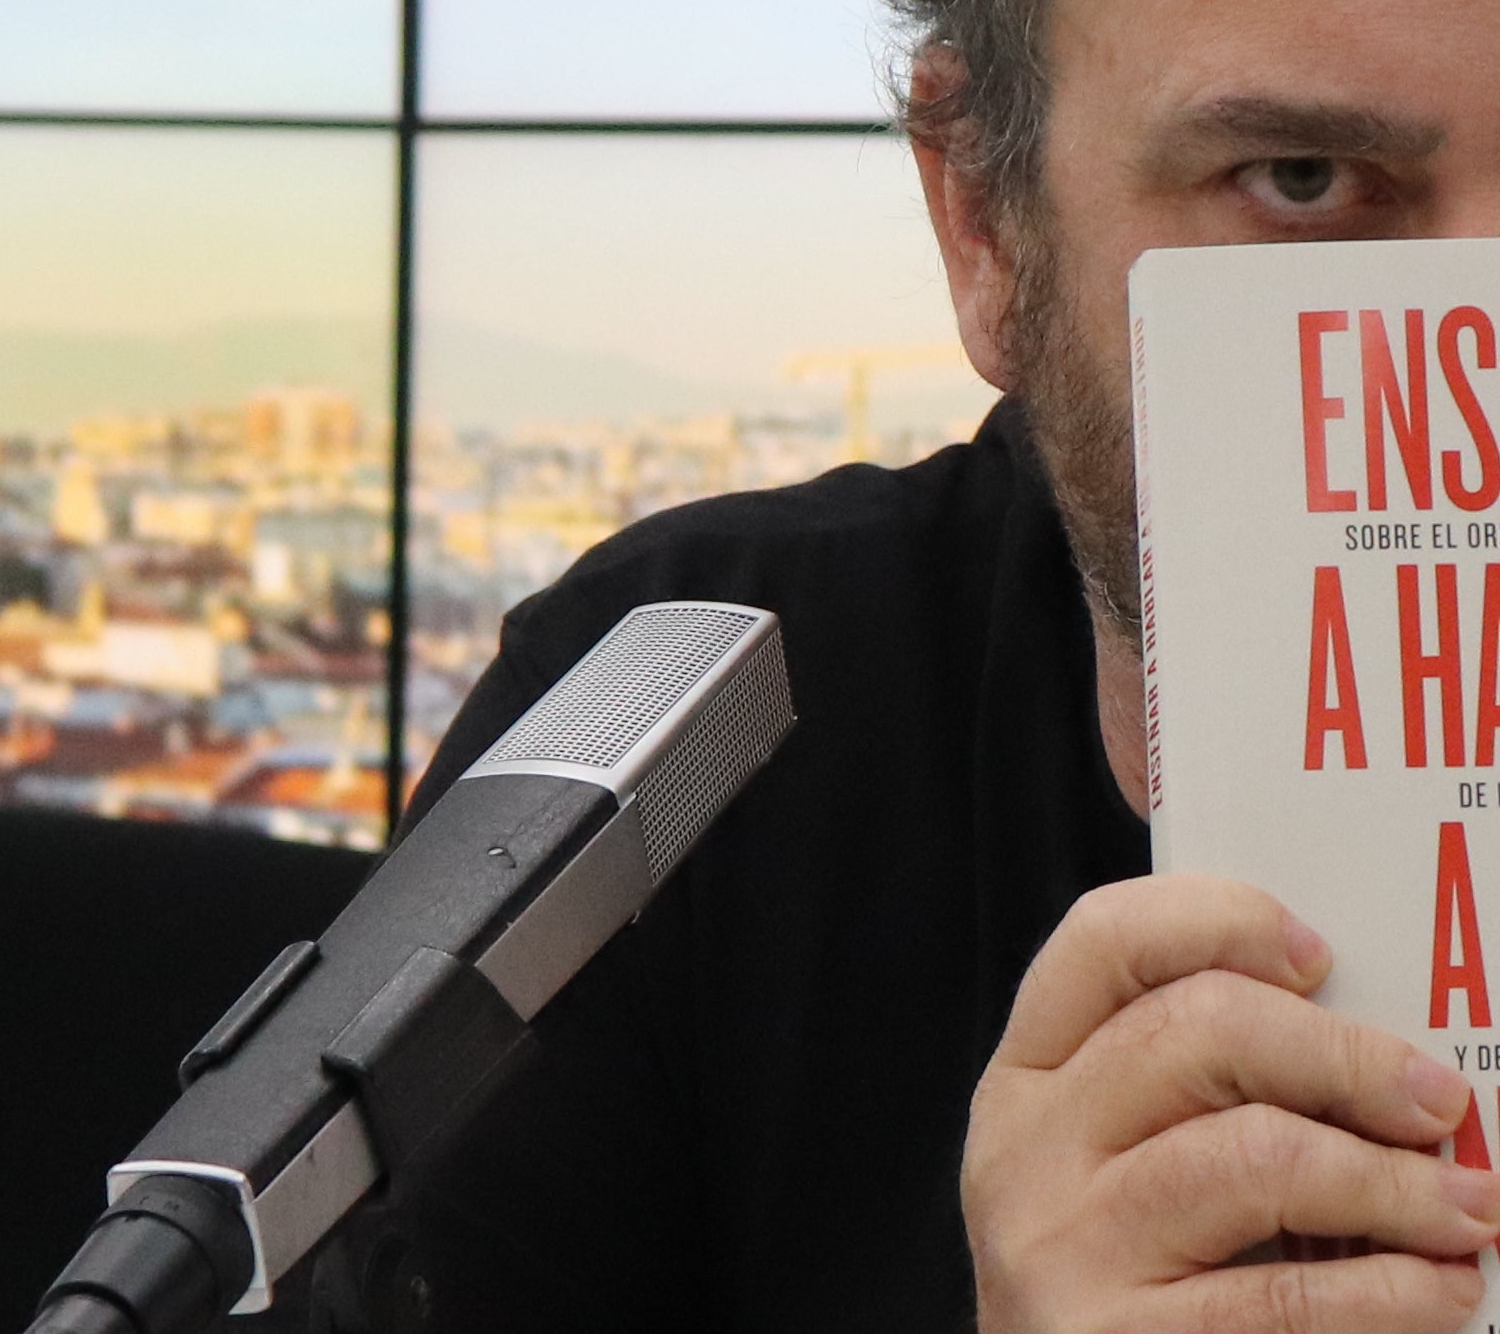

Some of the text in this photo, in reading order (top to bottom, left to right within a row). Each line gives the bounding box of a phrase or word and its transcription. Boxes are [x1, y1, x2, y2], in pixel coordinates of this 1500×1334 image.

[1345, 524, 1421, 551] SOBRE
[1432, 523, 1458, 549] EL
[1304, 566, 1368, 770] A
[1459, 782, 1487, 808] DE
[1428, 822, 1492, 1029] A
[1454, 1045, 1468, 1071] Y
